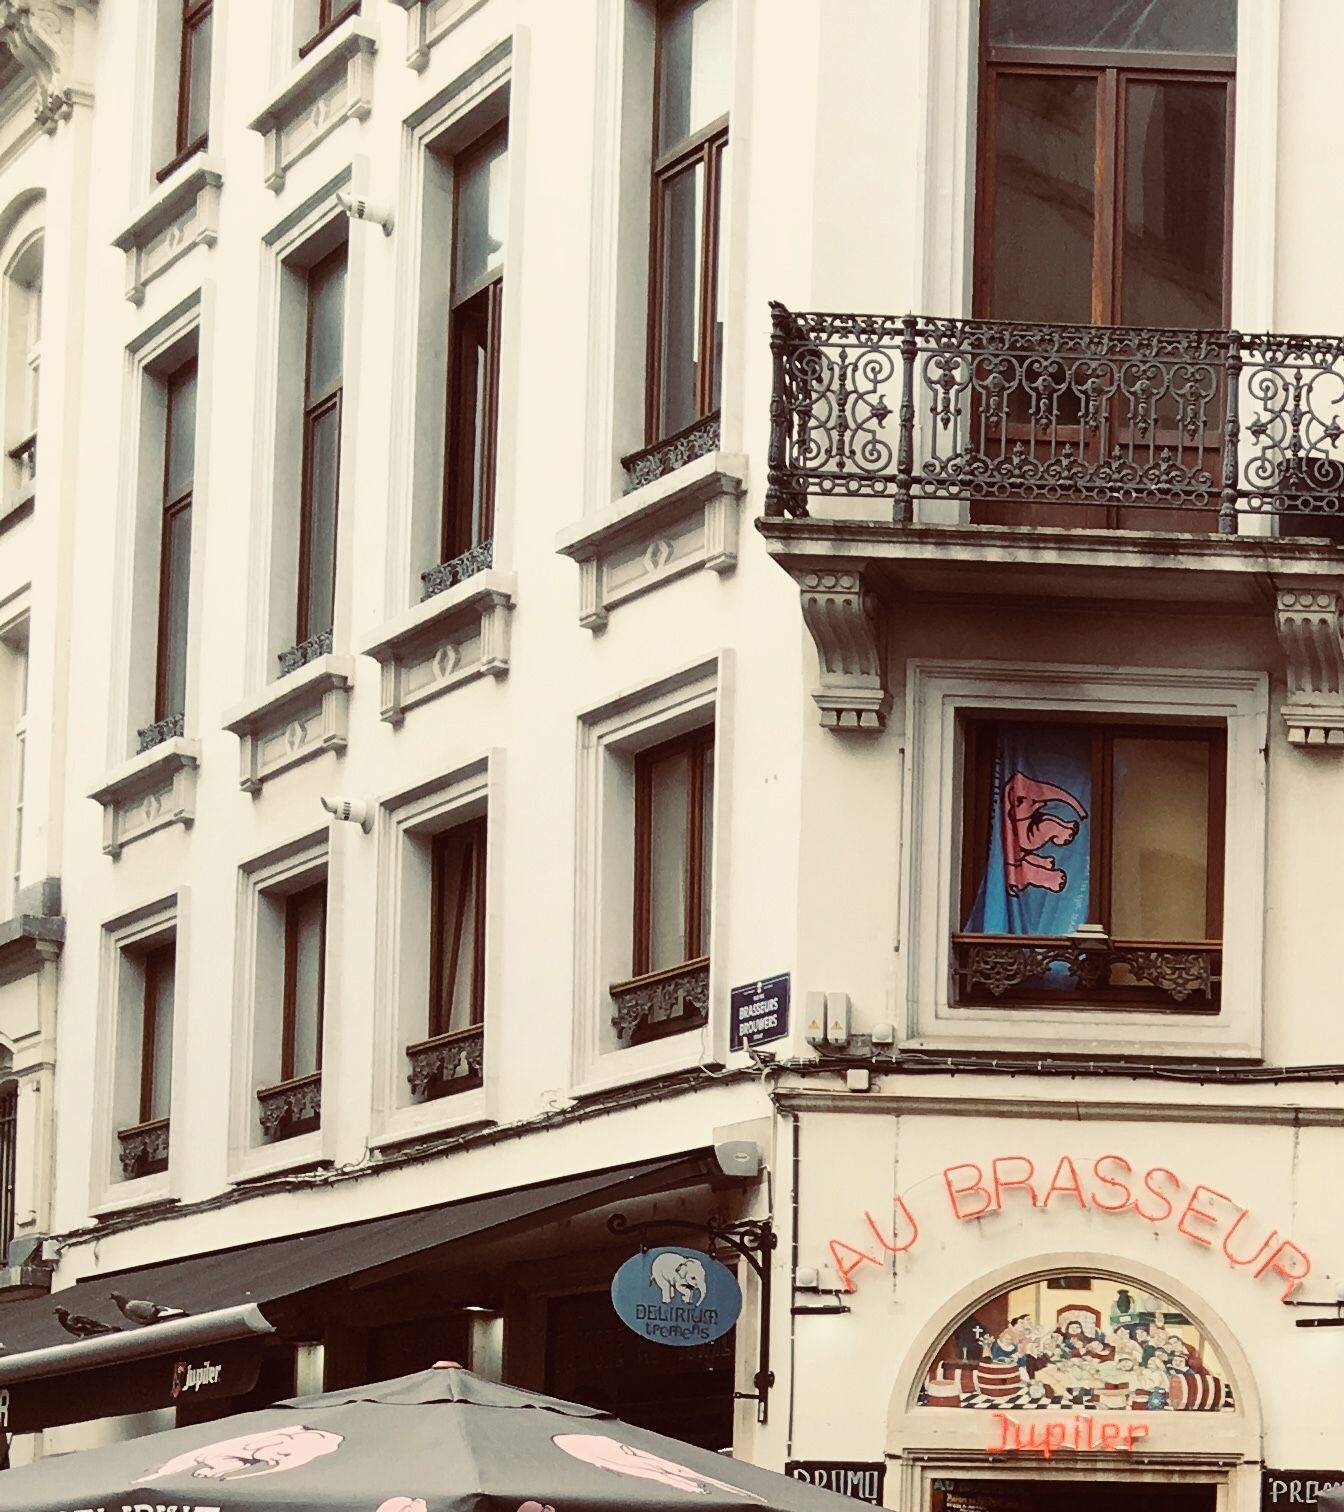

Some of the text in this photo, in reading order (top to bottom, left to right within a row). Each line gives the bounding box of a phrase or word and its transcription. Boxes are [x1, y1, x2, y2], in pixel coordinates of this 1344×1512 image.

[829, 1154, 1312, 1302] AU BRASSEUR
[636, 1303, 719, 1325] DELIRIUM
[986, 1412, 1151, 1459] Jupiler
